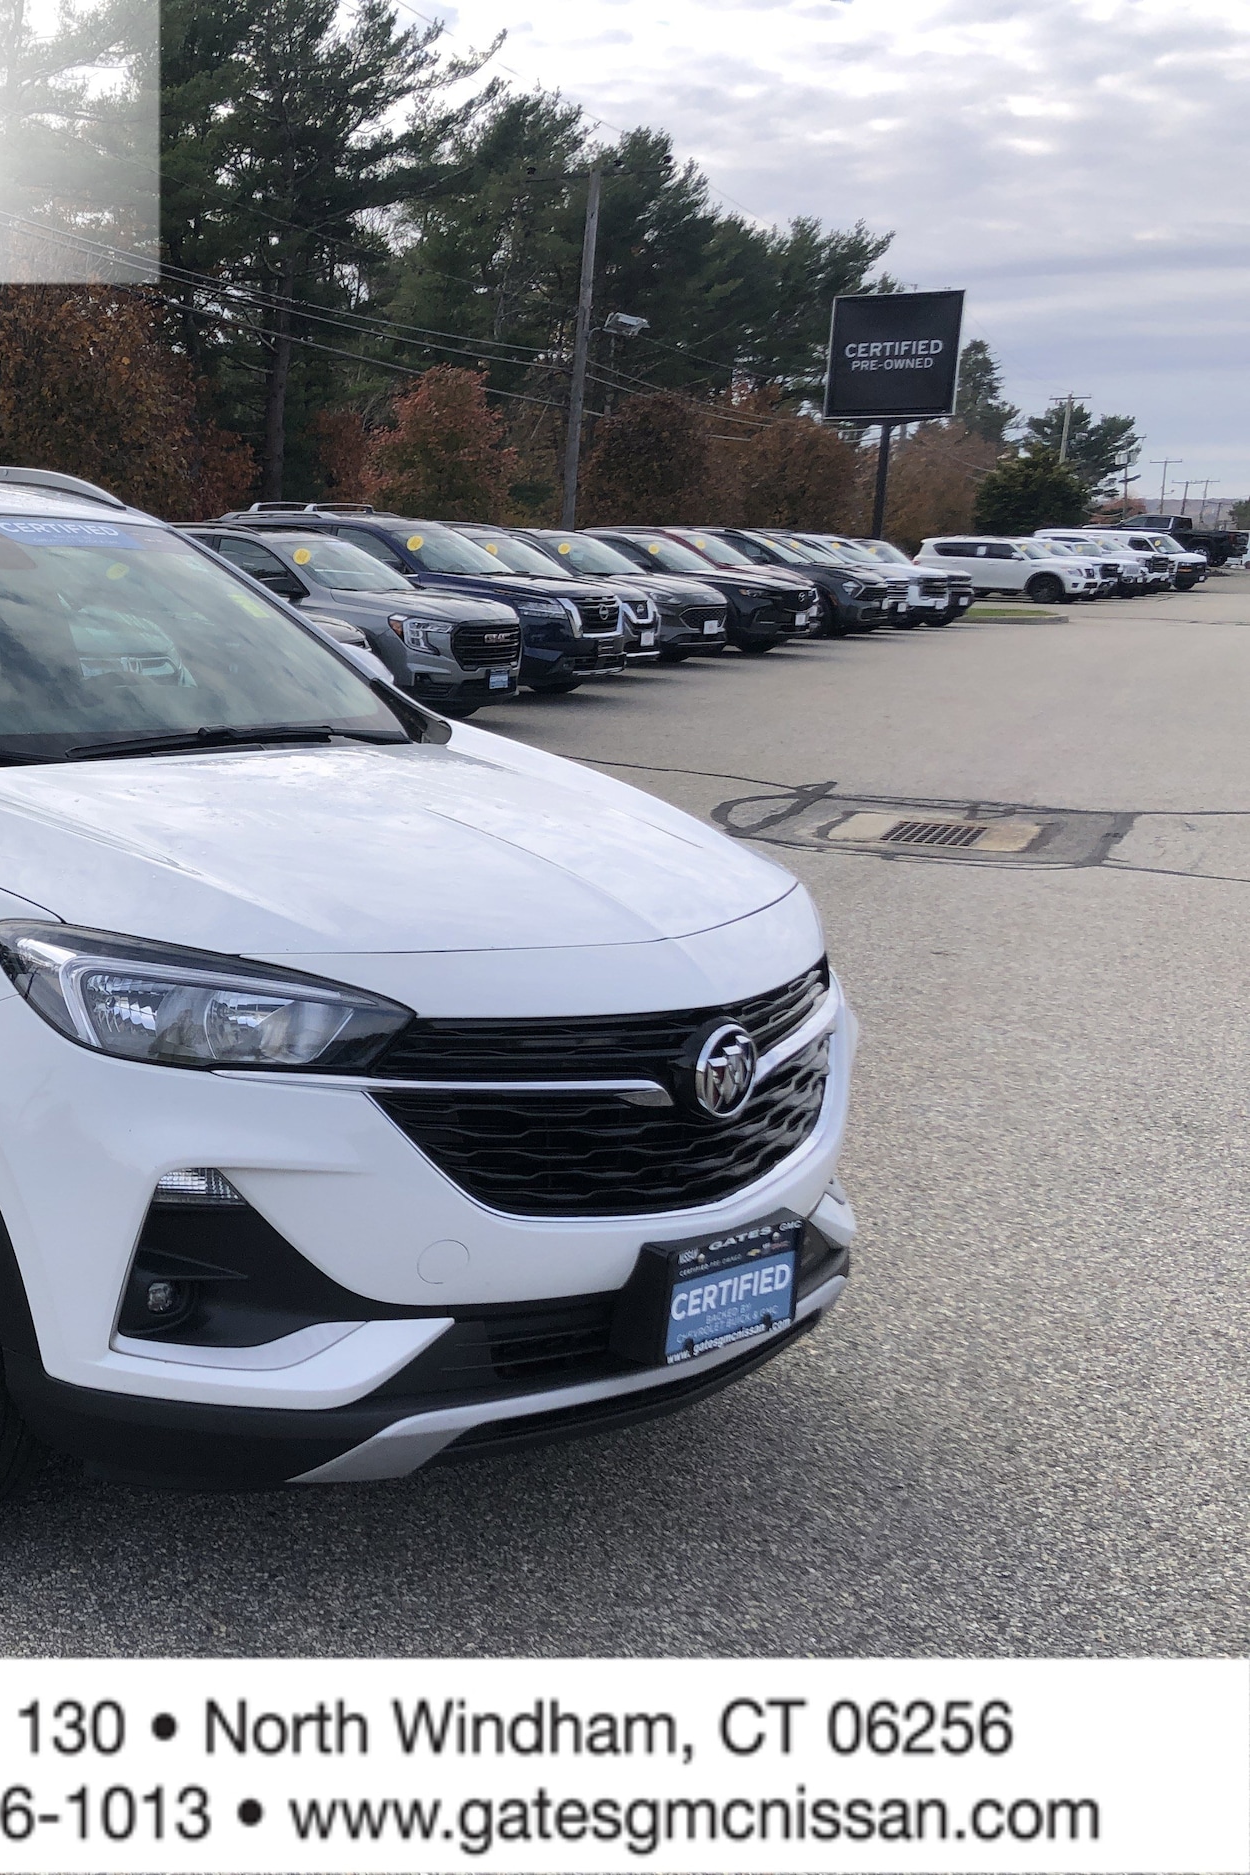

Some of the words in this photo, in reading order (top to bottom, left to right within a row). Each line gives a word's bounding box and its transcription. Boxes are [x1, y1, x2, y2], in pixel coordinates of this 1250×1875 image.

[845, 340, 943, 358] CERTIFIED
[851, 357, 934, 371] PRE-OWNED
[709, 1226, 772, 1251] GATES
[779, 1220, 803, 1232] GMC
[670, 1264, 791, 1321] CERTIFIED
[706, 1307, 738, 1324] BACKED
